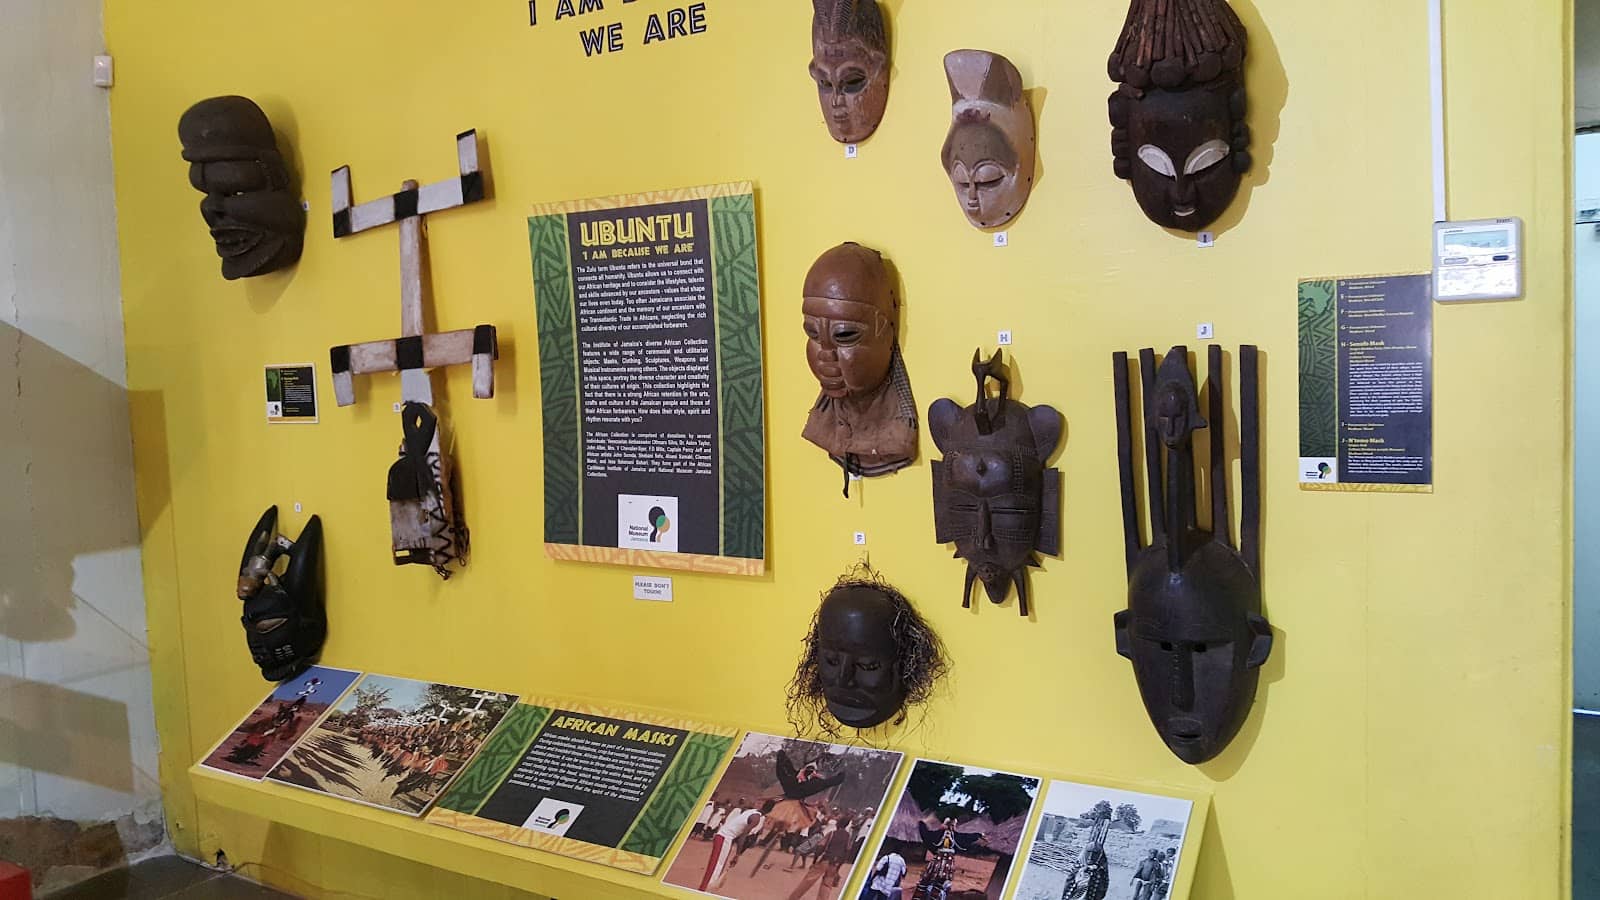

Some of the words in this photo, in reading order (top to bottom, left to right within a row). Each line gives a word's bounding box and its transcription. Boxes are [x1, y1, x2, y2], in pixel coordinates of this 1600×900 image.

[579, 22, 624, 57] WE
[643, 2, 707, 45] ARE
[848, 146, 854, 154] D
[580, 212, 694, 247] UBUNTU
[592, 250, 608, 260] AM
[612, 246, 650, 258] BECAUSE
[655, 245, 669, 255] WE
[1000, 334, 1008, 342] H
[1201, 326, 1207, 335] J
[551, 716, 620, 737] AFRICAN
[623, 727, 678, 746] MASKS
